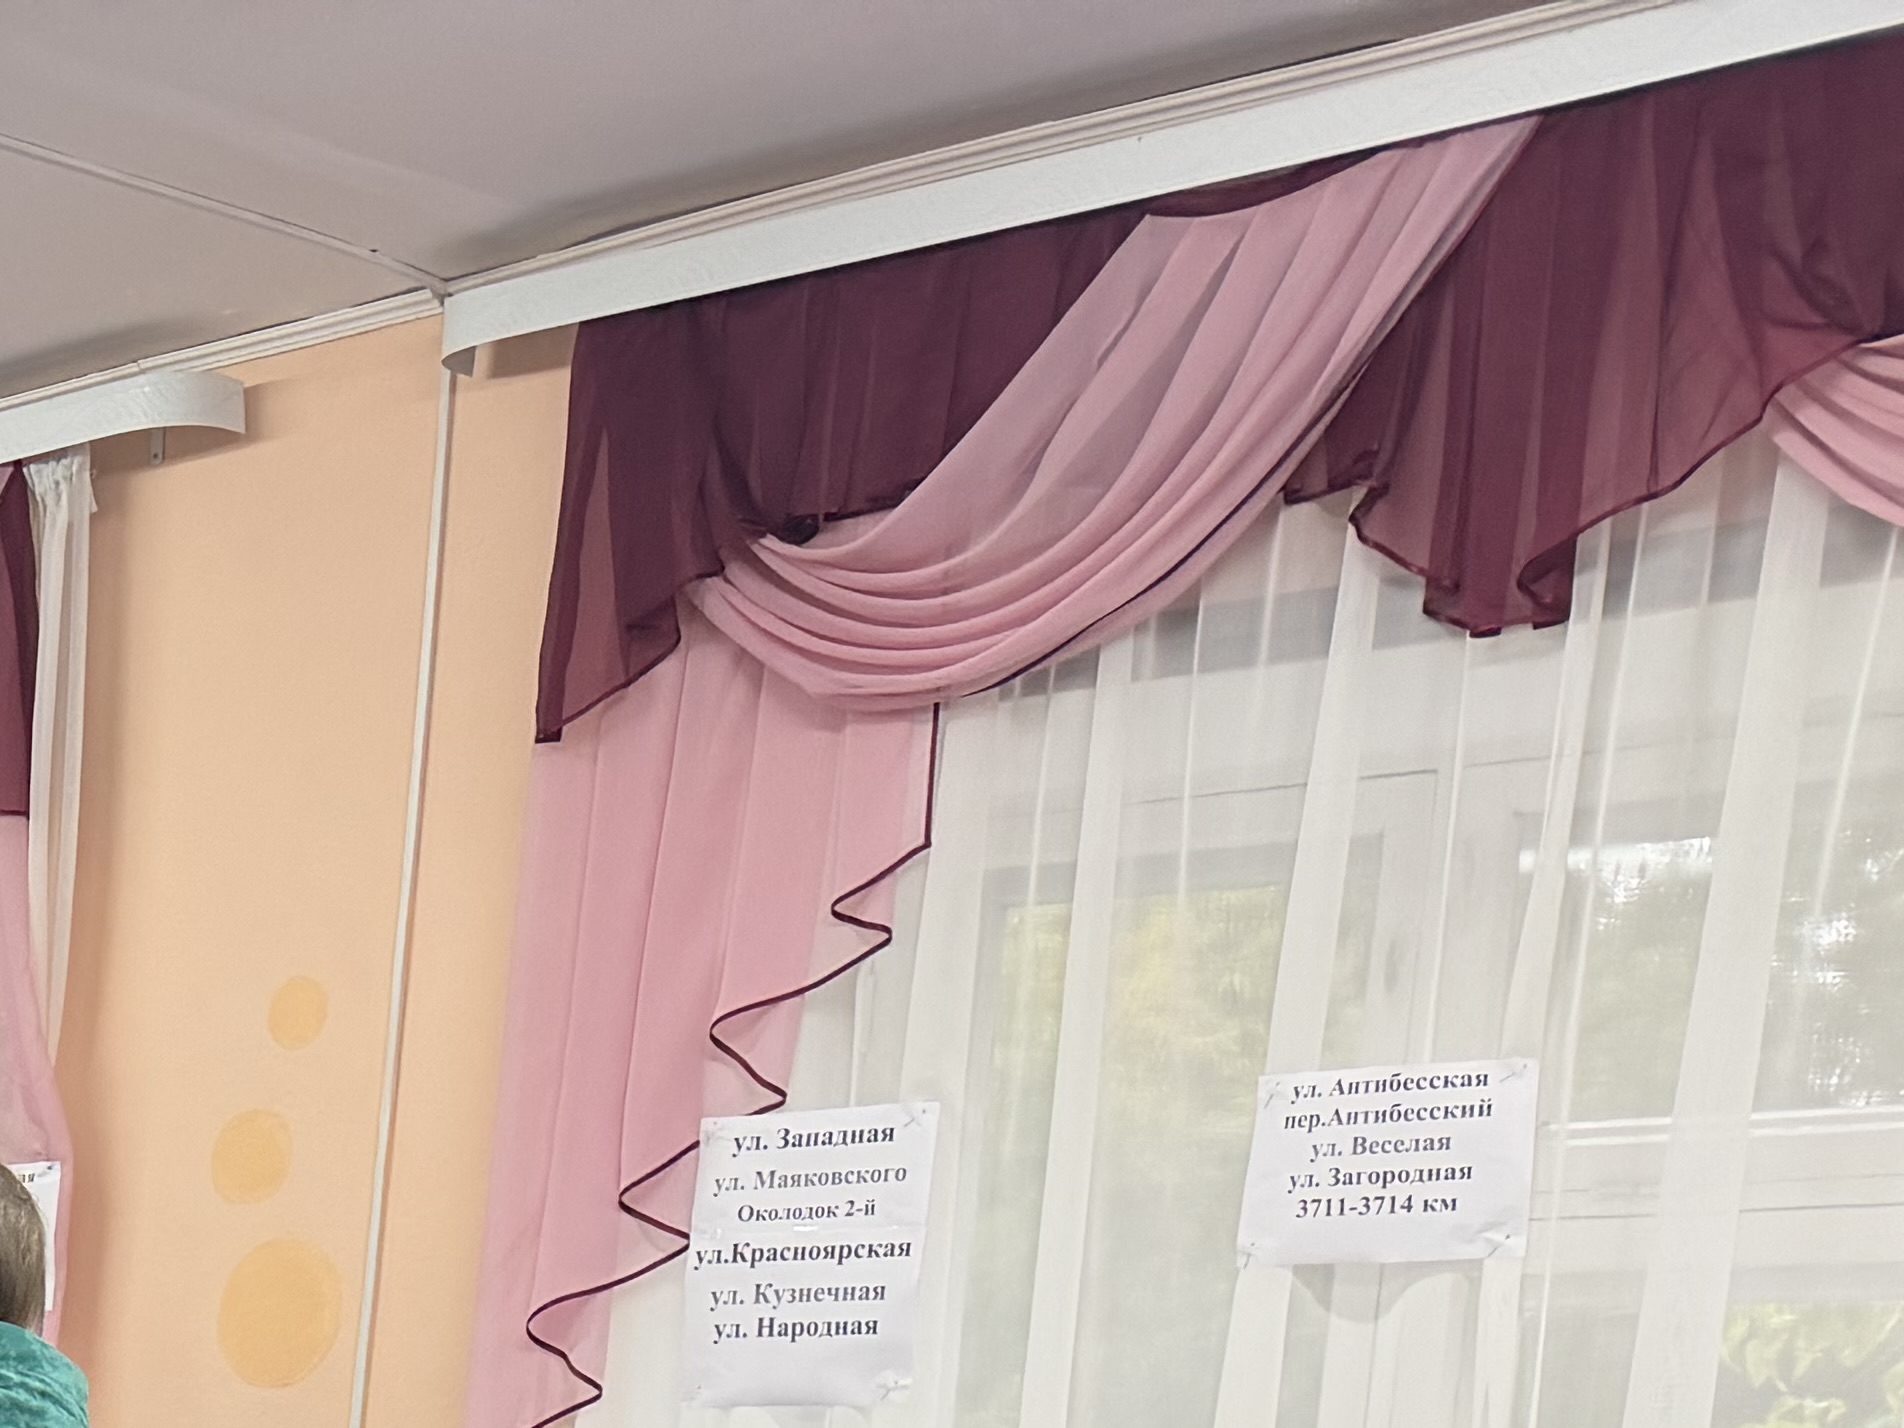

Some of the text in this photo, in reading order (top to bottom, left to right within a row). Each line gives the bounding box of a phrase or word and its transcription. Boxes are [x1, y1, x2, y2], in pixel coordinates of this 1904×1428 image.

[1291, 1072, 1489, 1104] ул. Антибесская
[1284, 1098, 1493, 1133] пер.Антибесский
[732, 1126, 896, 1158] ул. Западная
[1310, 1136, 1451, 1163] ул. Веселая
[713, 1167, 907, 1197] ул. Маяковского
[1287, 1165, 1473, 1194] ул. Загородная
[737, 1199, 876, 1223] Околодок 2-й
[1295, 1194, 1457, 1219] 3711-3714 км
[694, 1241, 912, 1270] ул.Красноярская
[710, 1283, 887, 1311] ул. Кузнечная
[713, 1316, 879, 1344] ул. Народная
